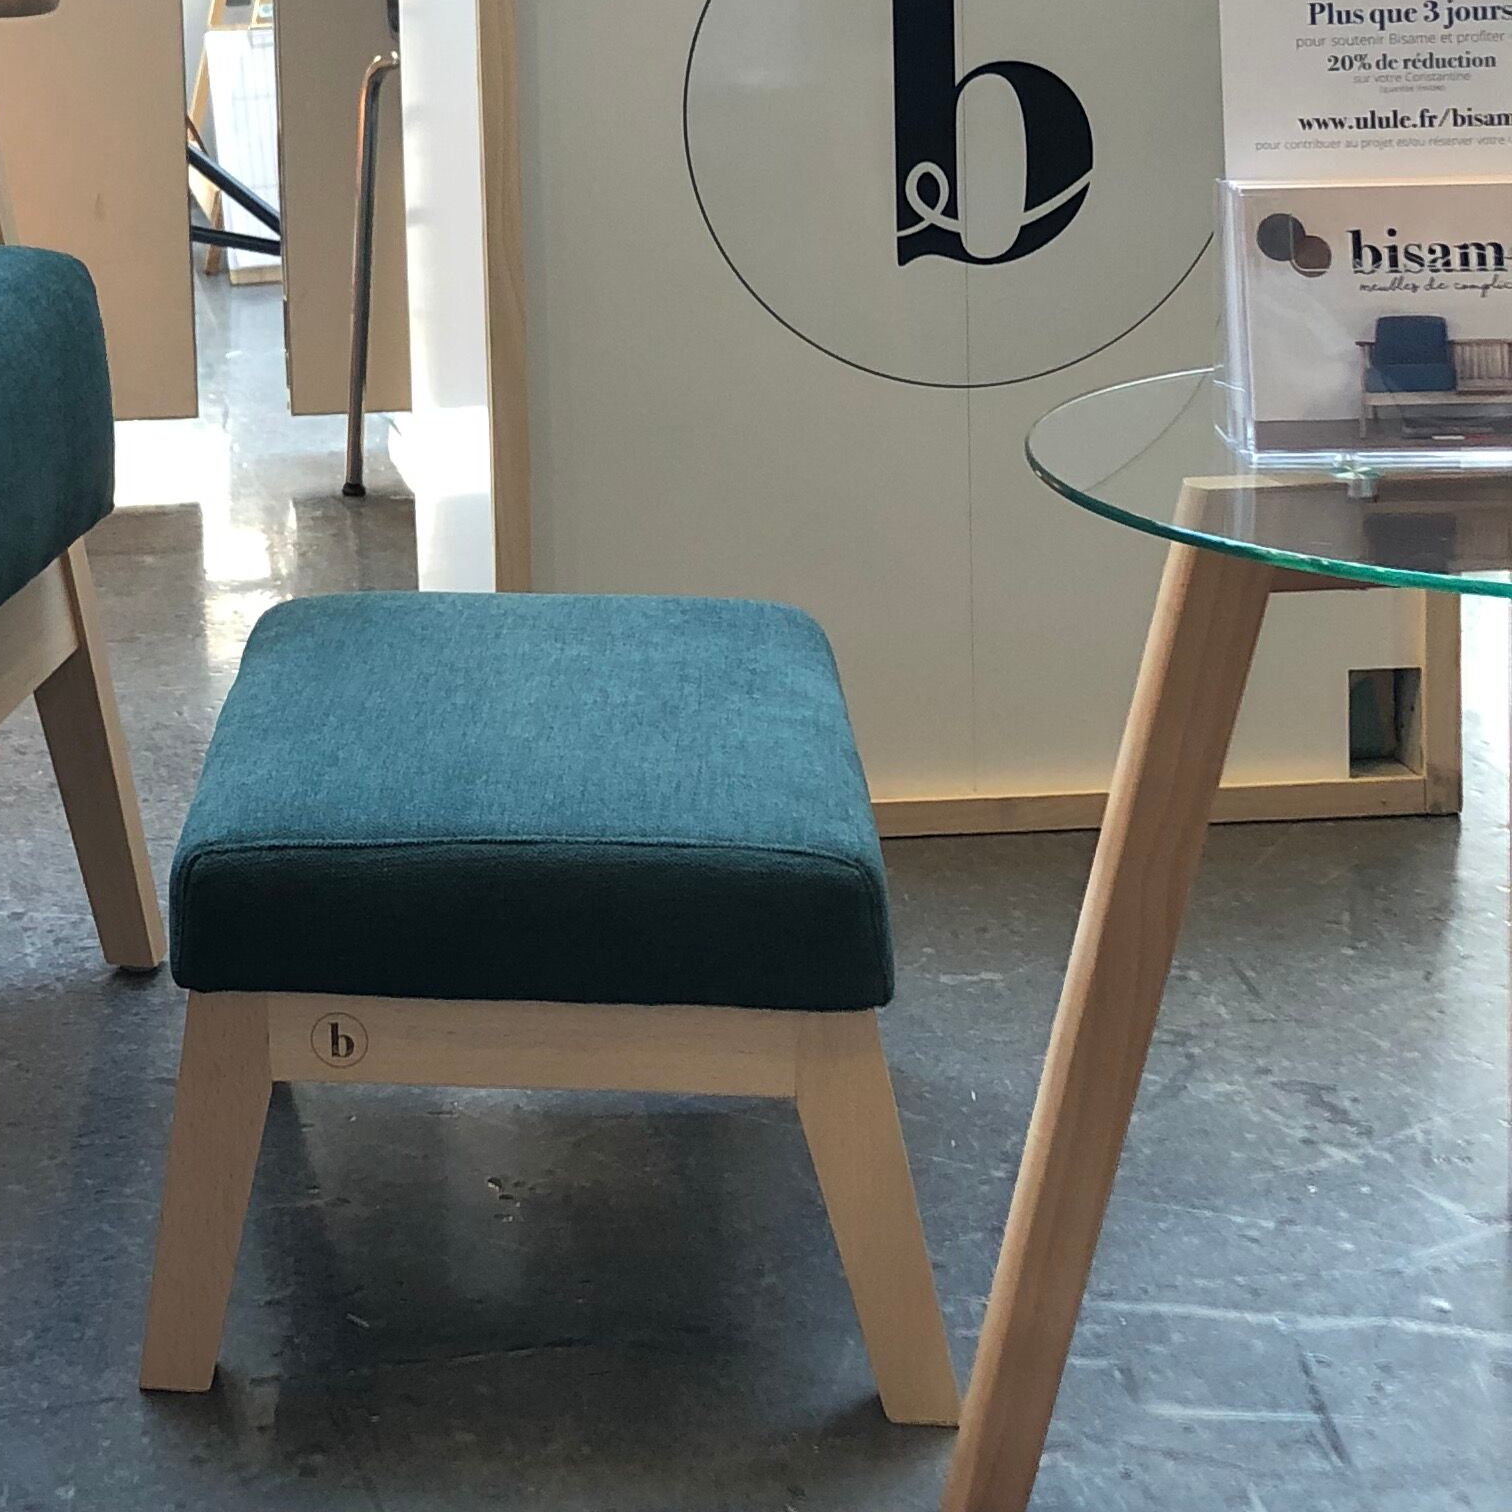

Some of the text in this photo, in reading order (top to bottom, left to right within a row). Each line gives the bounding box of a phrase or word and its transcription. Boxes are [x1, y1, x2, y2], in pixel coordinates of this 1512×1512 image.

[1307, 1, 1364, 25] Plus
[1369, 6, 1418, 31] que
[1423, 0, 1440, 22] 3
[1296, 30, 1504, 49] pour soutenir Bisame et profiter
[1327, 50, 1497, 72] 20% de réduction
[1353, 71, 1472, 83] sur votre Constantine
[1255, 140, 1281, 152] pour
[1284, 138, 1341, 150] contribuer
[1345, 138, 1358, 148] au
[1361, 137, 1395, 151] projet
[1428, 134, 1473, 147] réserver
[1345, 228, 1512, 275] bisam
[1424, 276, 1449, 291] de
[328, 1021, 355, 1058] b
